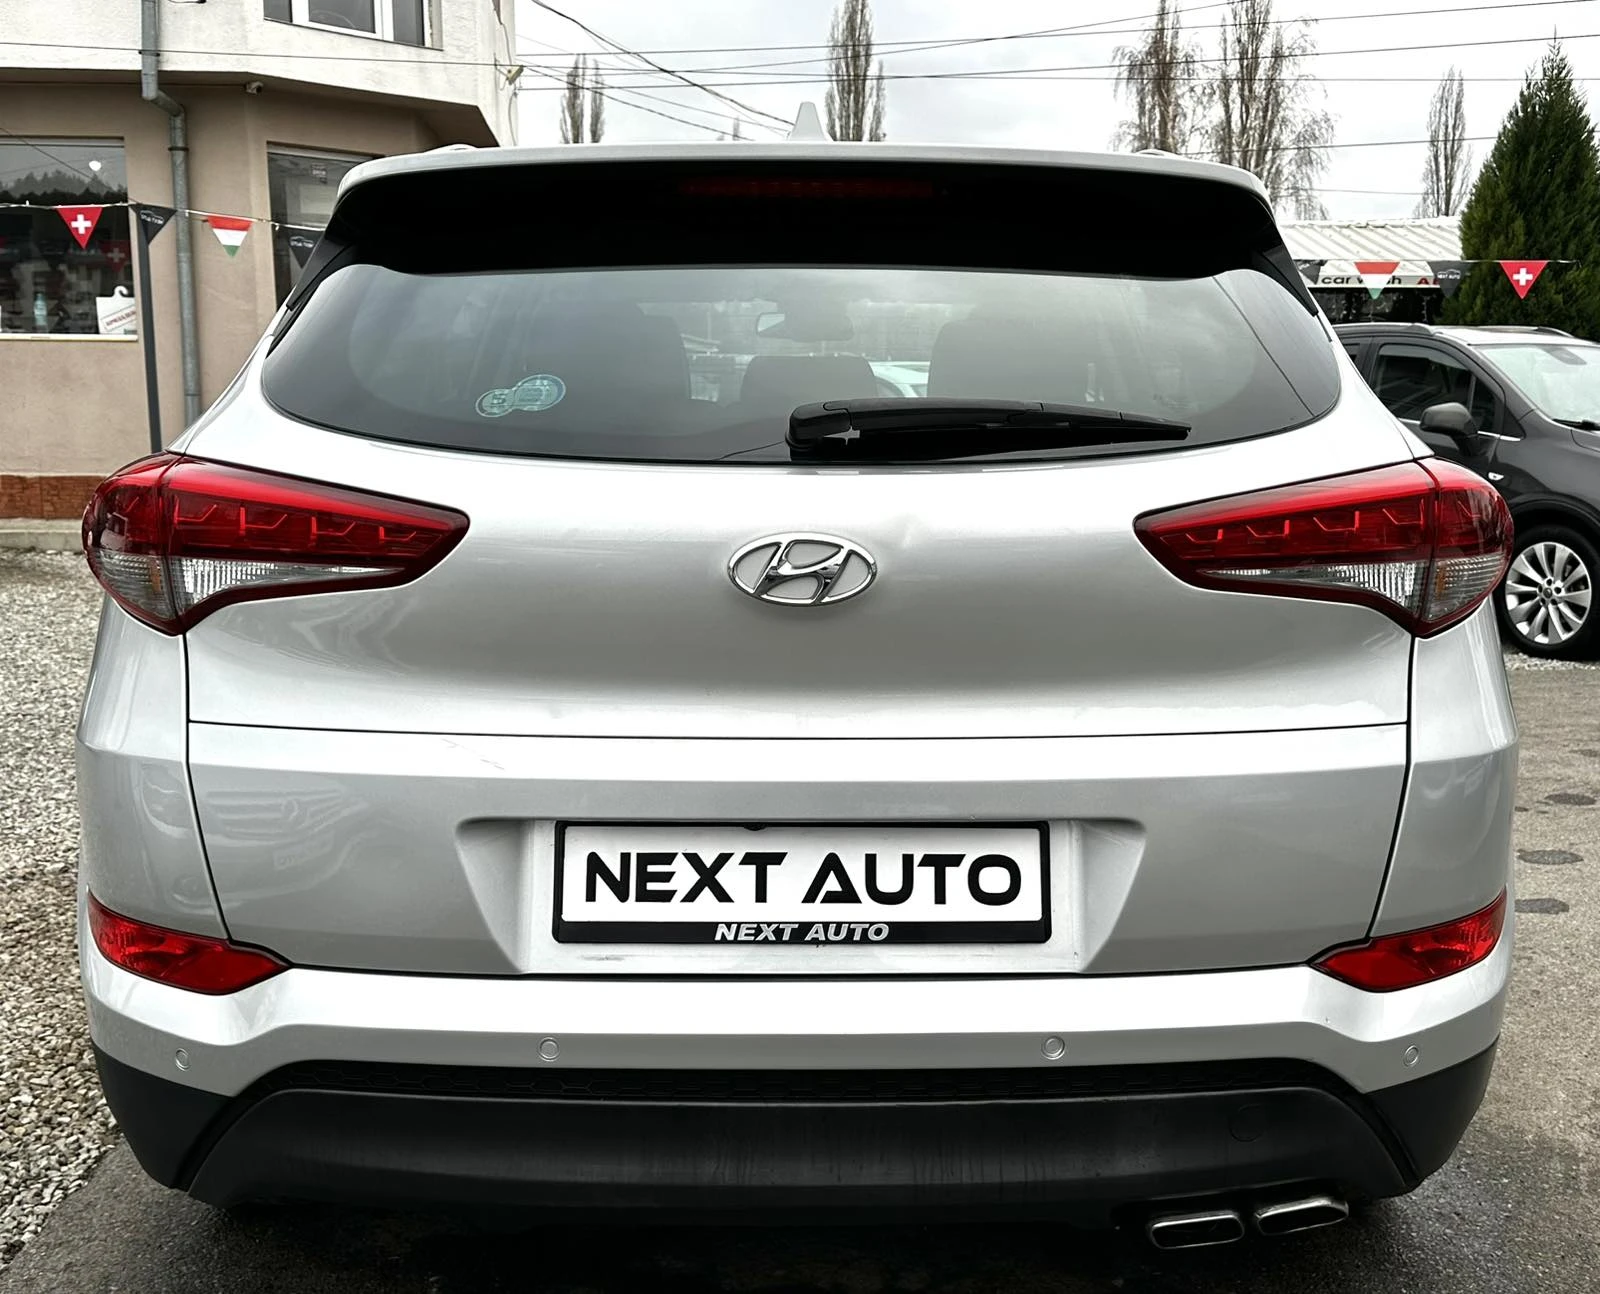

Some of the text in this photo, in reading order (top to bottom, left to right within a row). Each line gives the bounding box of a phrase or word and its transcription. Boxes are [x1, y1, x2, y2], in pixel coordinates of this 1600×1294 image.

[1321, 276, 1350, 285] car
[585, 851, 1022, 905] NEXT AUTO
[714, 923, 891, 942] NEXT AUTO
